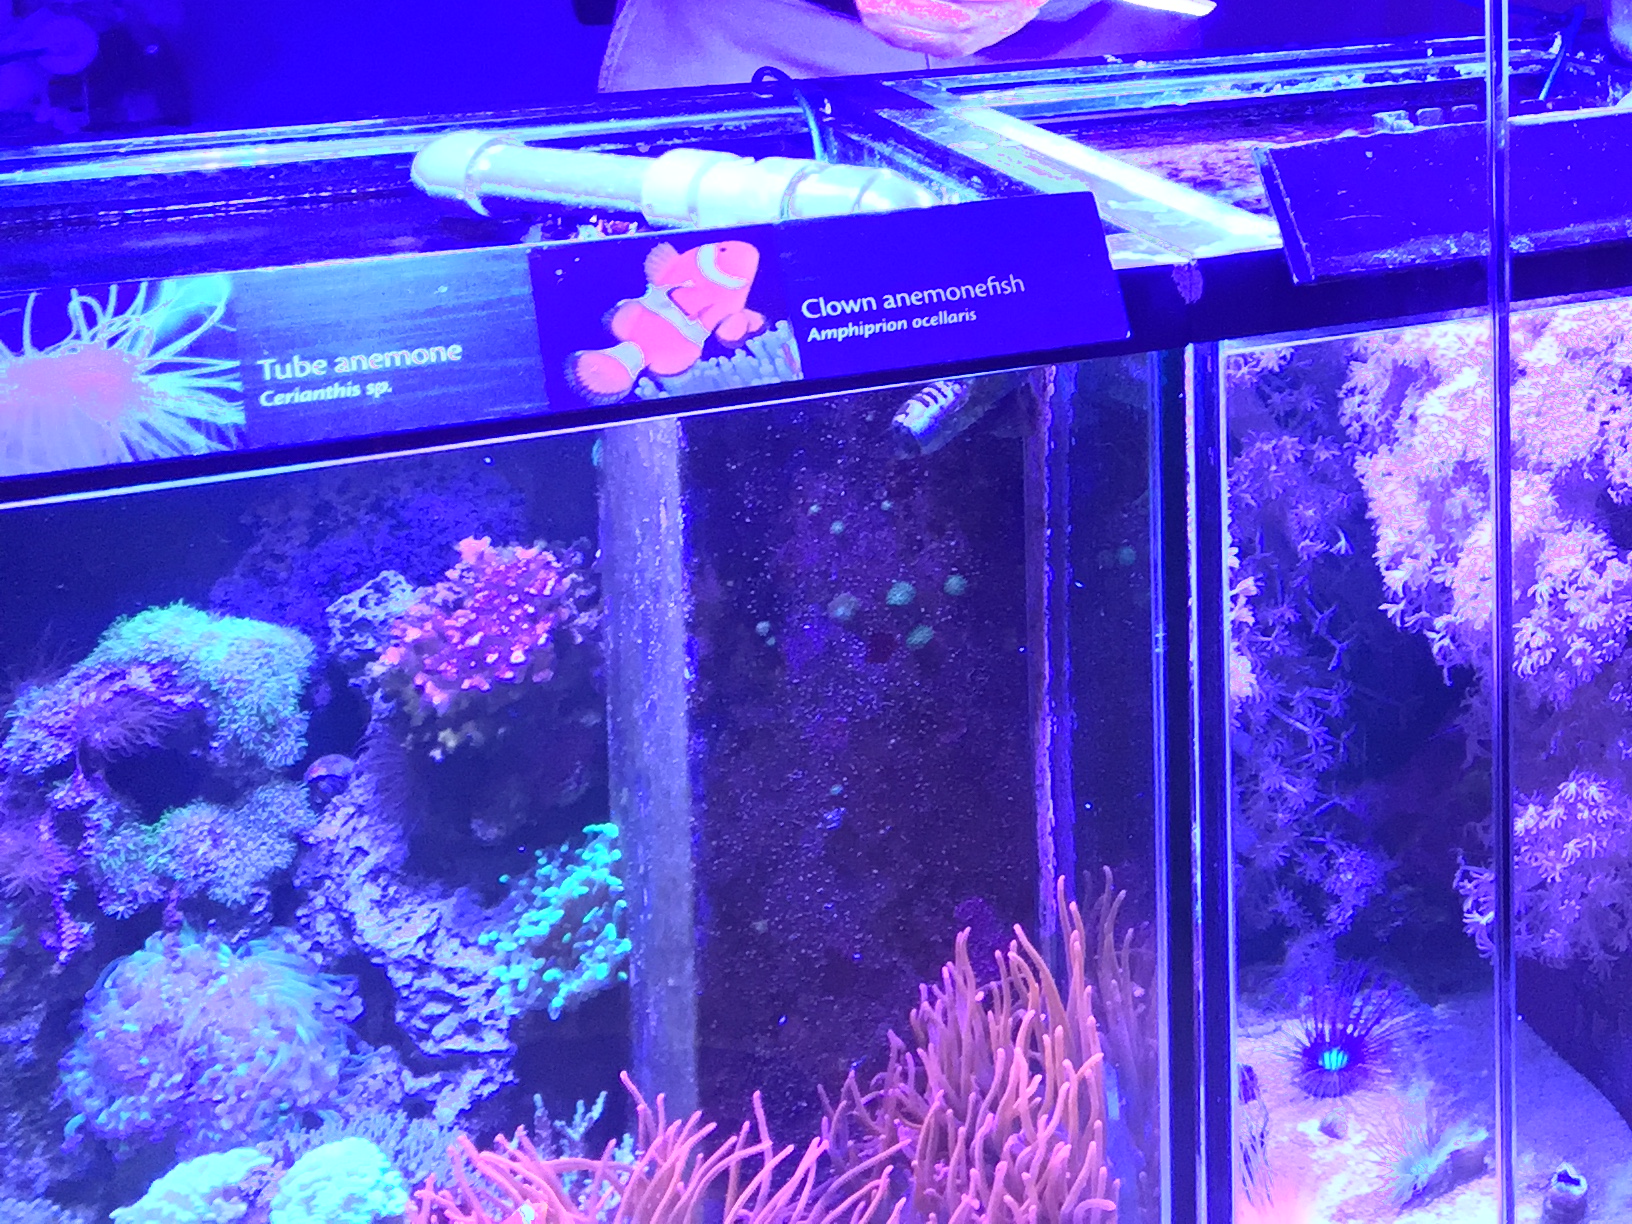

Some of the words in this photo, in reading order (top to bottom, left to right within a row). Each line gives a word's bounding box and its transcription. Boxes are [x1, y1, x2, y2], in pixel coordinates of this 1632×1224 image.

[801, 296, 877, 319] Clown
[882, 273, 1025, 309] anemonefish
[807, 318, 908, 343] Amphiprion
[912, 307, 977, 329] ocellaris
[256, 354, 328, 381] Tube
[333, 344, 463, 373] anemone
[259, 380, 360, 407] Cerianthis
[365, 380, 392, 398] sp.
